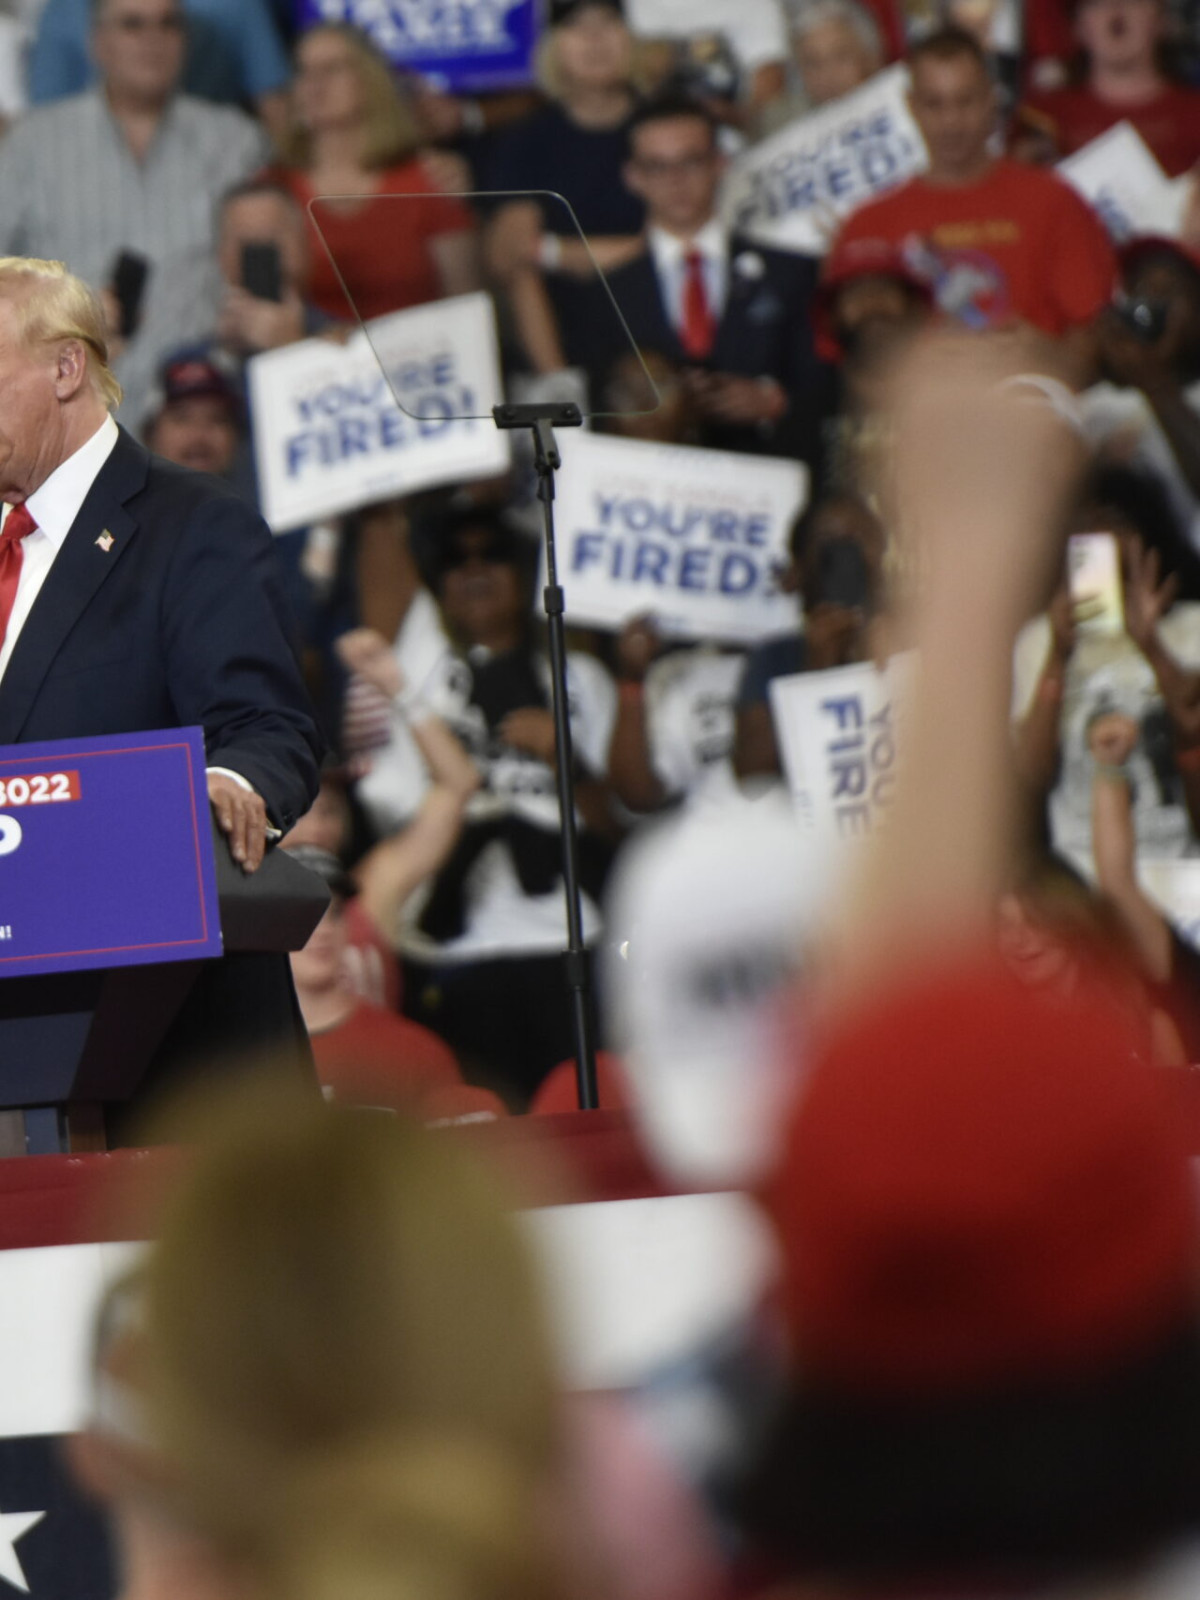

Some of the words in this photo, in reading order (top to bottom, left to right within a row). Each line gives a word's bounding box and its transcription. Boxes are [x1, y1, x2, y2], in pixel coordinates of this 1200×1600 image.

[285, 386, 476, 480] FIRED!
[294, 352, 455, 424] YOU'RE
[596, 492, 771, 549] YOU'RE
[820, 692, 872, 838] FIRE
[869, 701, 896, 808] YOU
